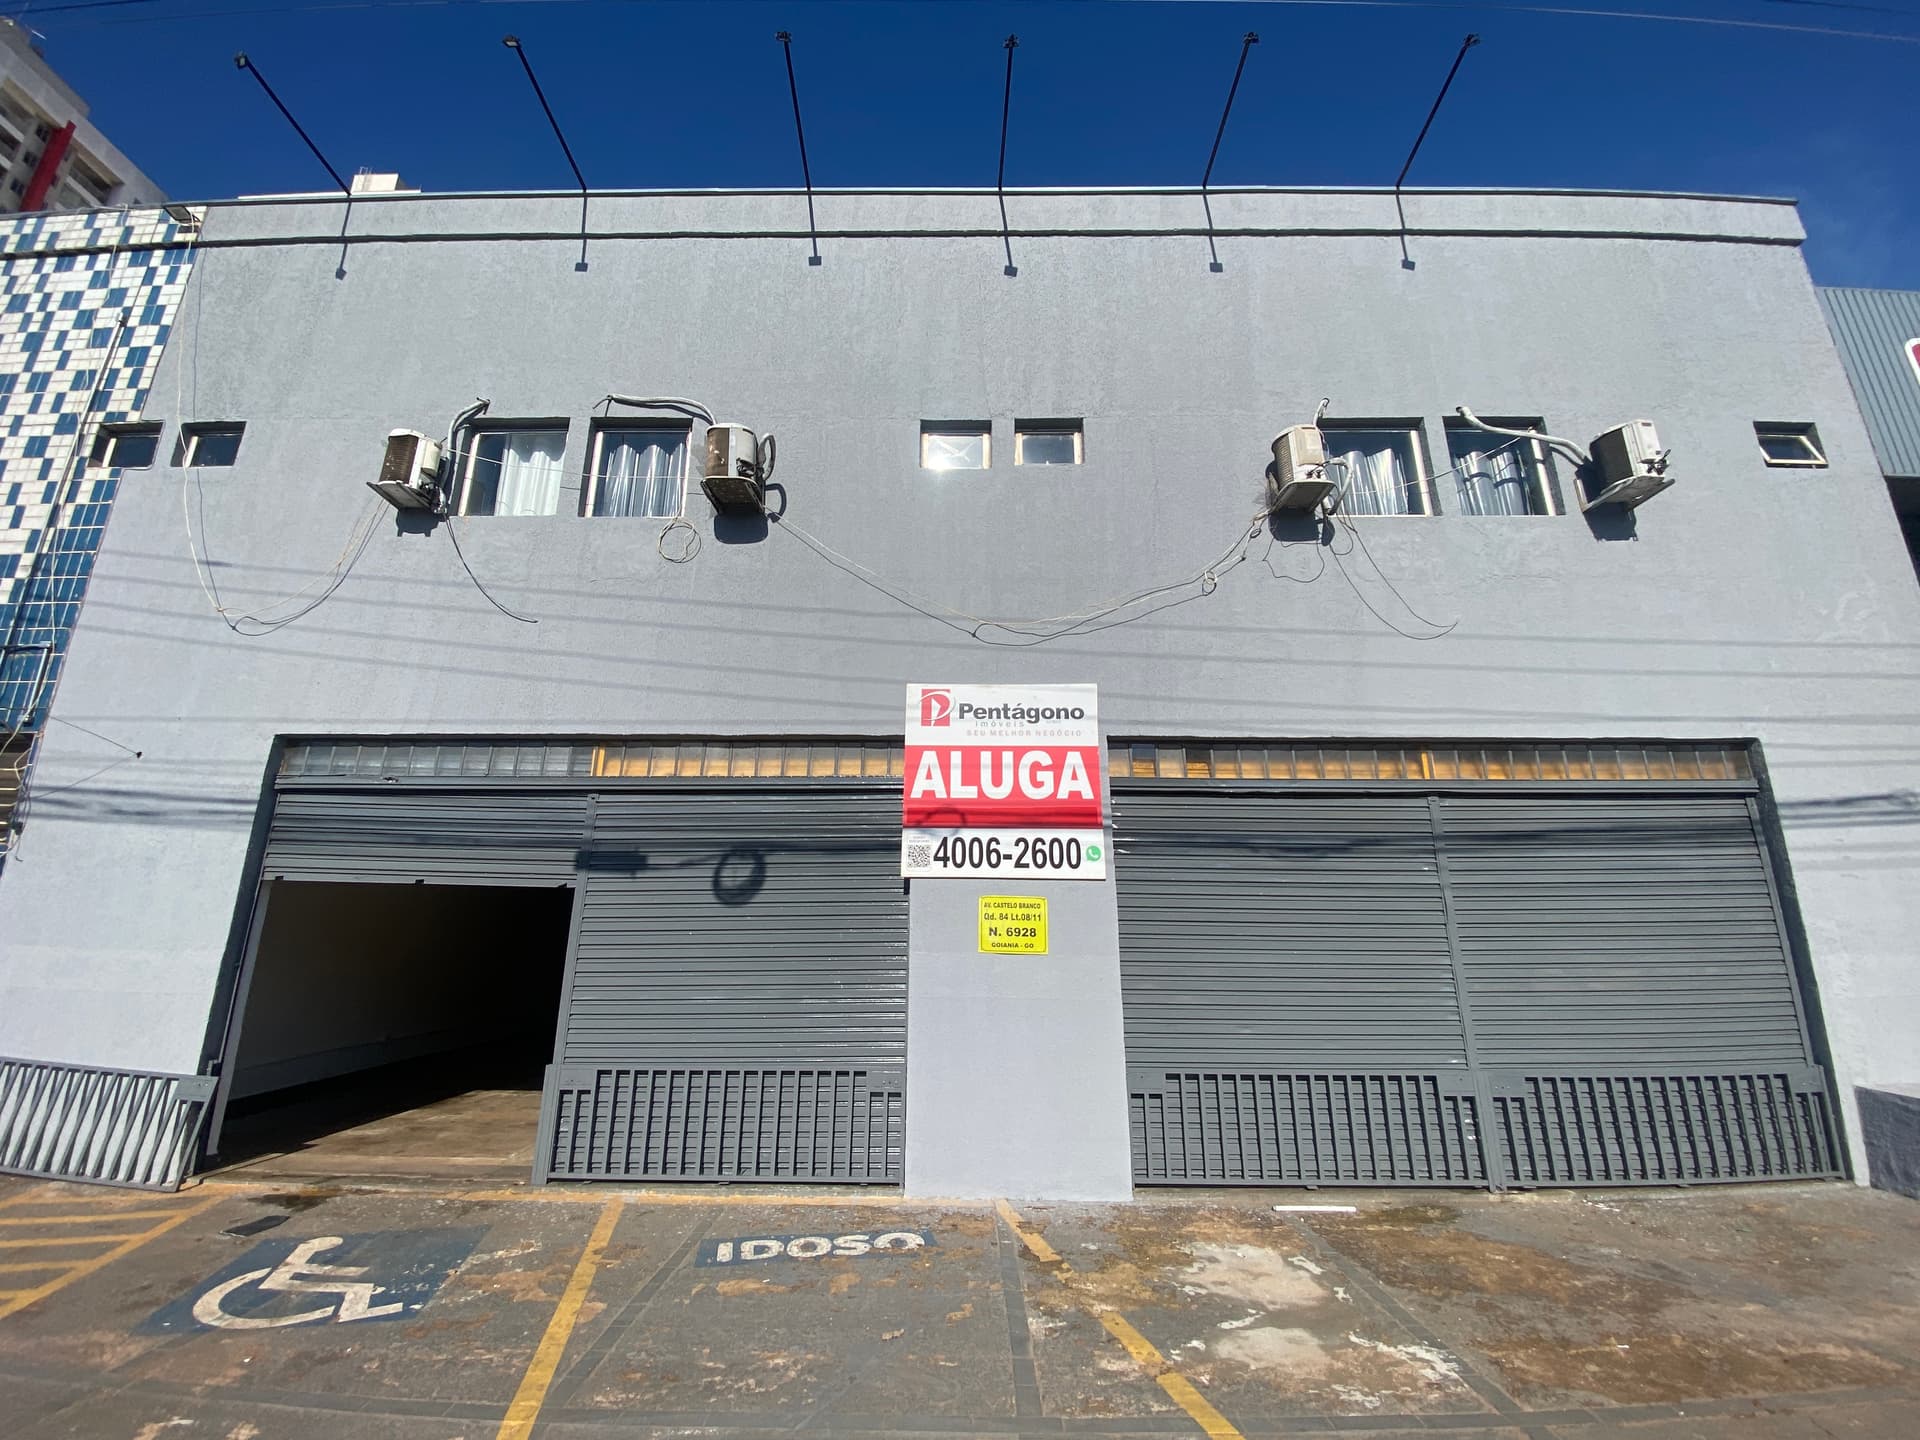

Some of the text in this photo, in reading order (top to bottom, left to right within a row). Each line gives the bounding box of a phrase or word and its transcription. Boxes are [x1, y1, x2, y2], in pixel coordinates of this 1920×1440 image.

[958, 702, 1085, 724] Pentágono
[966, 728, 1082, 737] SEU MELHOR NEGÓCIO
[910, 750, 1094, 800] ALUGA
[933, 836, 1082, 869] 4006-2600
[1019, 902, 1041, 910] BRANCO
[984, 912, 997, 921] Qd.
[999, 912, 1009, 921] 84
[989, 926, 1037, 938] N. 6928
[716, 1232, 926, 1262] IDOSO
